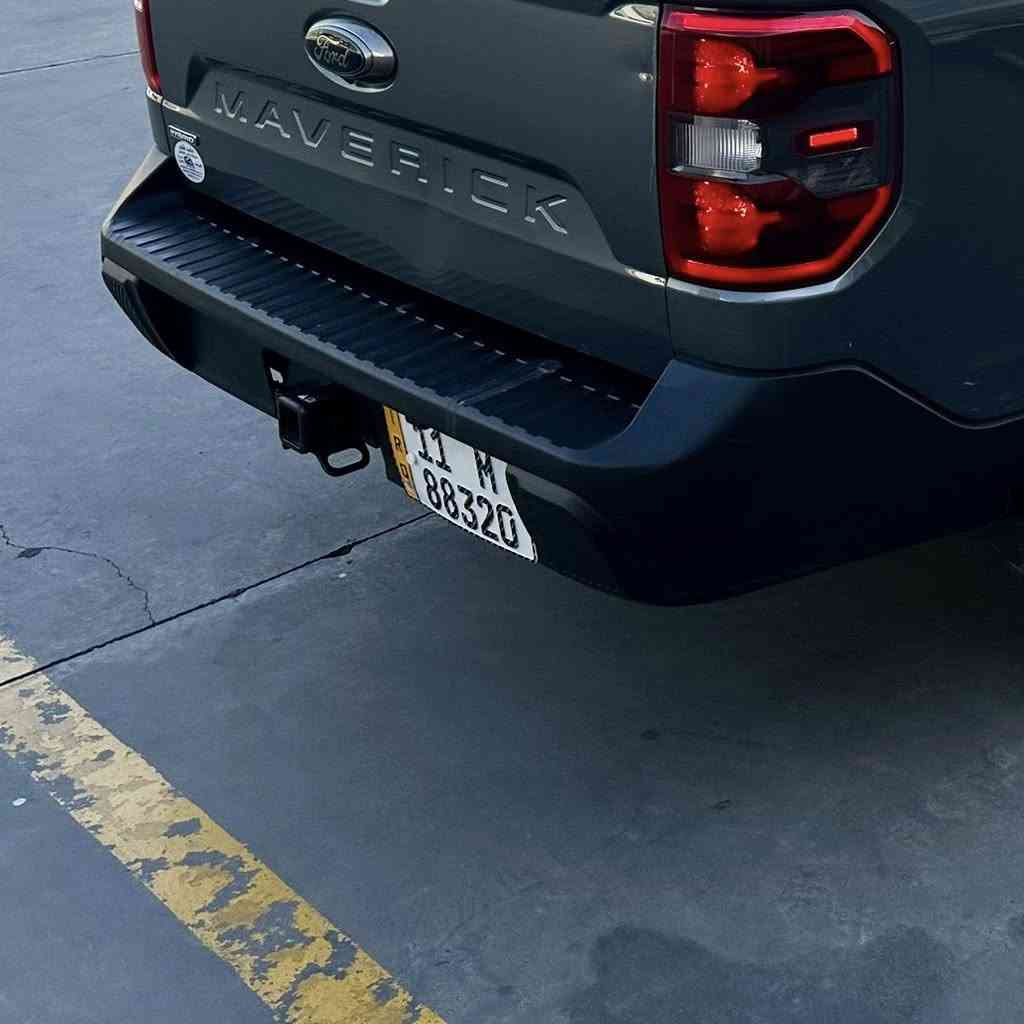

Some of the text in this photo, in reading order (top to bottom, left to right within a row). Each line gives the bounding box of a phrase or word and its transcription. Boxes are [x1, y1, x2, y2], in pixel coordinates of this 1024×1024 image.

[314, 34, 352, 68] Ford
[214, 82, 568, 234] MAVERICK
[418, 429, 498, 494] 11 M
[423, 467, 519, 549] 88320
